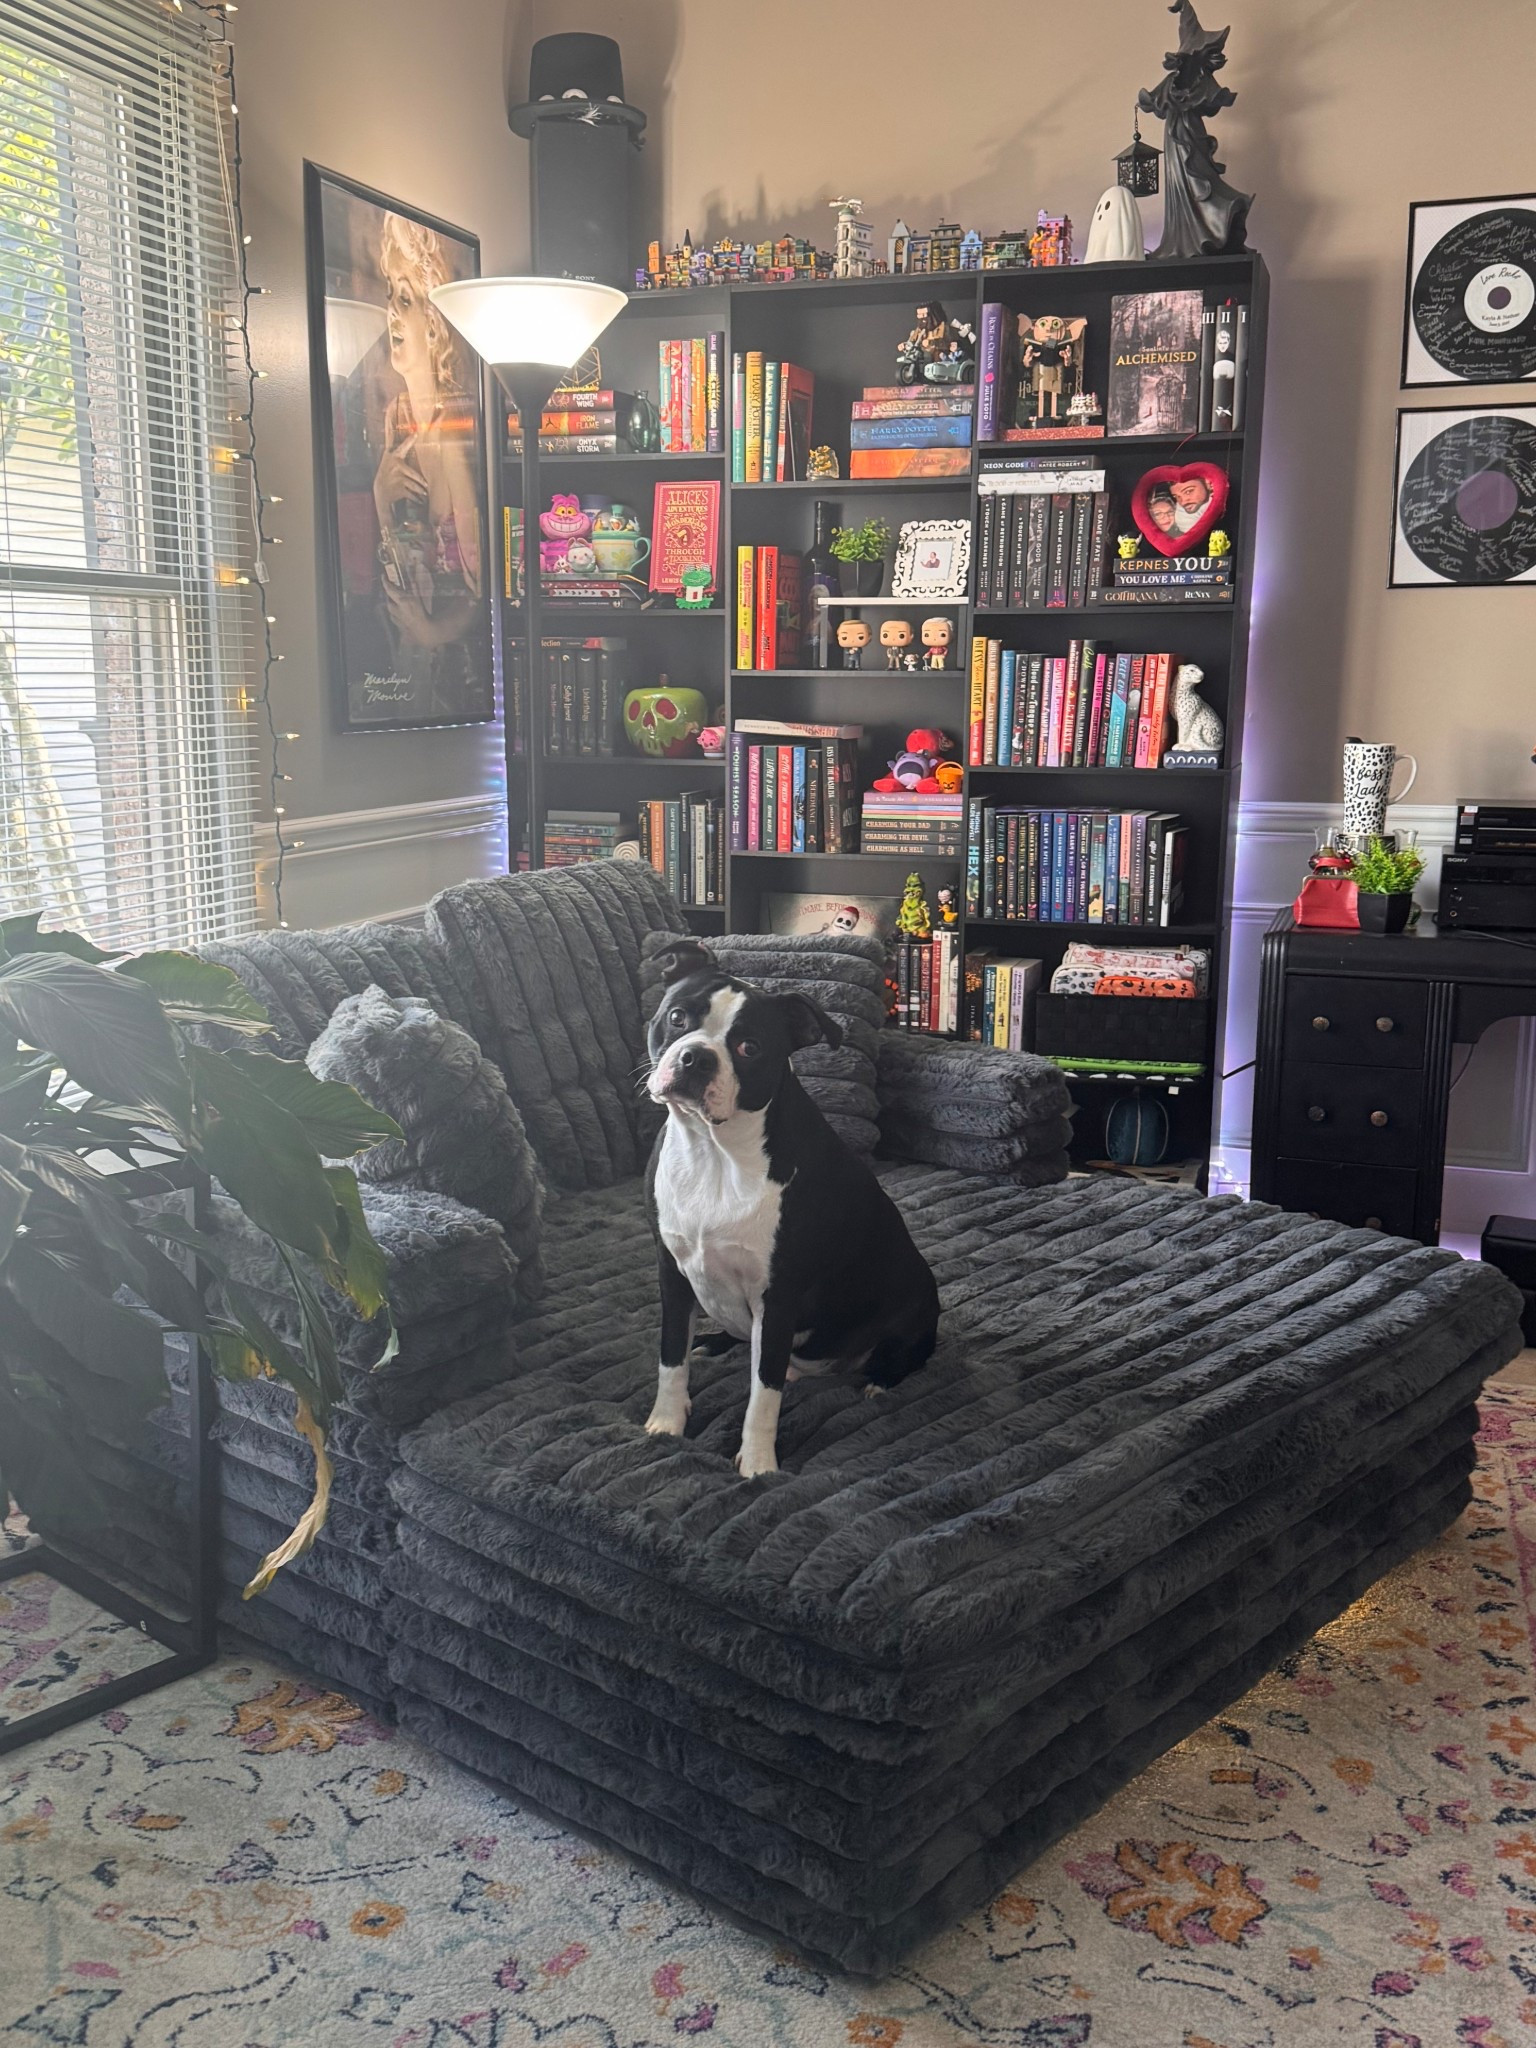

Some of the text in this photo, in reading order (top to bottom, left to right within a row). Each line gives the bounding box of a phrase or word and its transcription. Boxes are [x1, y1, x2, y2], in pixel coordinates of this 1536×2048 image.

[1481, 274, 1495, 285] Love
[1221, 312, 1230, 323] II
[987, 342, 995, 369] CHAINS
[1116, 351, 1197, 365] ALCHEMISED
[579, 438, 597, 446] ONYX
[1093, 544, 1101, 562] FATE
[1120, 557, 1213, 571] KEPNES YOU
[1120, 575, 1186, 584] YOU LOVE ME
[973, 682, 982, 706] HEART
[1357, 767, 1386, 781] Boss
[1355, 781, 1384, 799] Lady
[968, 845, 979, 876] HEX
